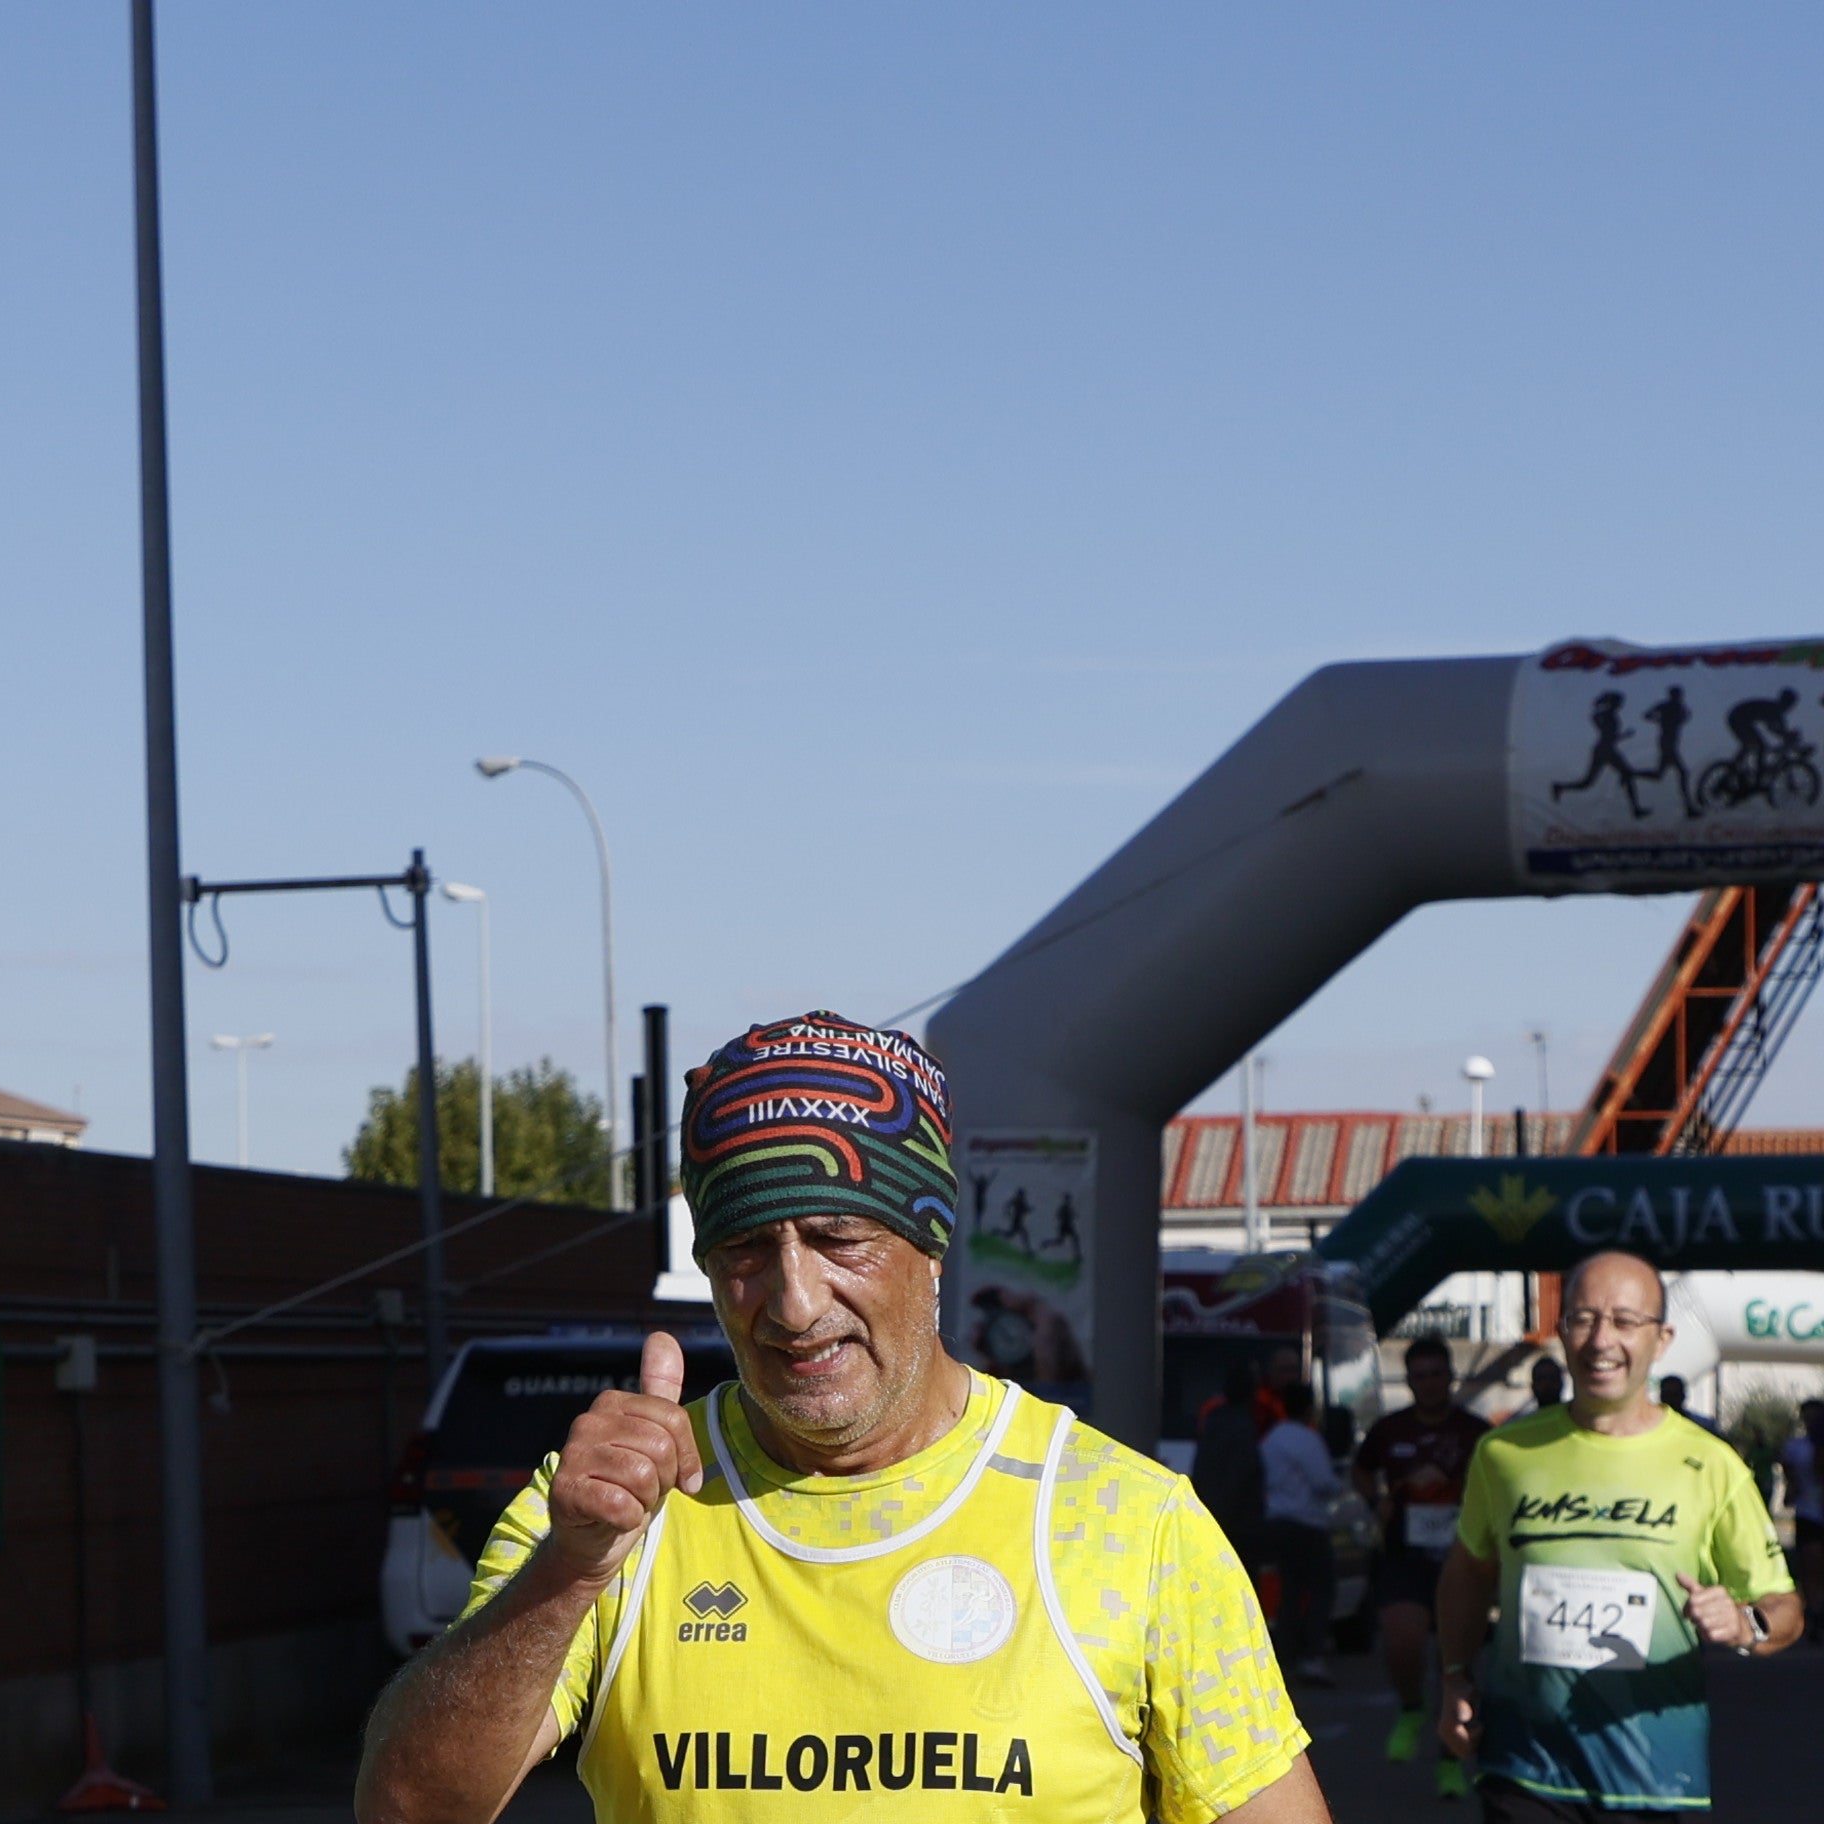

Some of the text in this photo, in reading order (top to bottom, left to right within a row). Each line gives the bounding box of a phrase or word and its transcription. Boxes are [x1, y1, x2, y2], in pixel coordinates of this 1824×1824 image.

[753, 1041, 945, 1117] SAN SILVESTRE
[789, 1024, 945, 1092] SALMANTINA
[749, 1097, 870, 1128] XXXVIII
[1564, 1184, 1740, 1256] CAJA
[1745, 1297, 1780, 1338] El
[677, 1619, 747, 1643] errea
[1547, 1599, 1624, 1638] 442
[653, 1732, 1034, 1797] VILLORUELA
